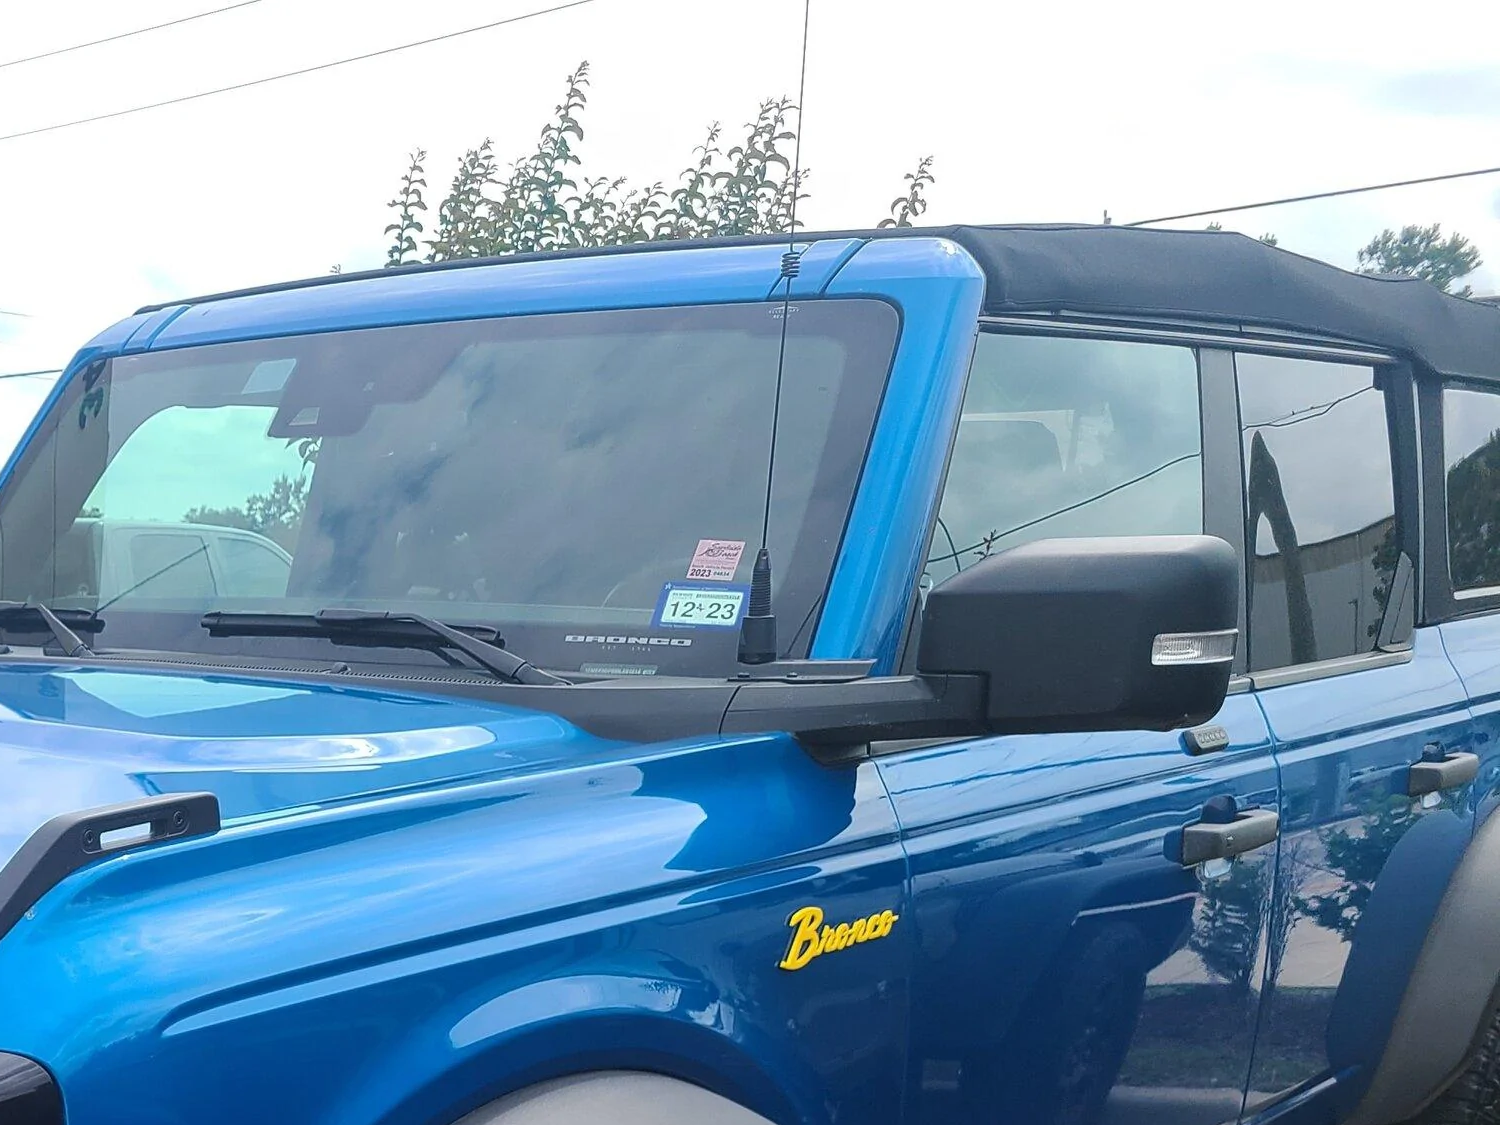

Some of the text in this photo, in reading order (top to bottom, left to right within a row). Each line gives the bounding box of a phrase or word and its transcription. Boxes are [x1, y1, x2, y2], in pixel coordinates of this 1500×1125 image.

[690, 568, 712, 578] 2023
[670, 601, 736, 620] 12 23
[565, 634, 692, 647] BRONCO
[780, 906, 899, 970] Bronco
